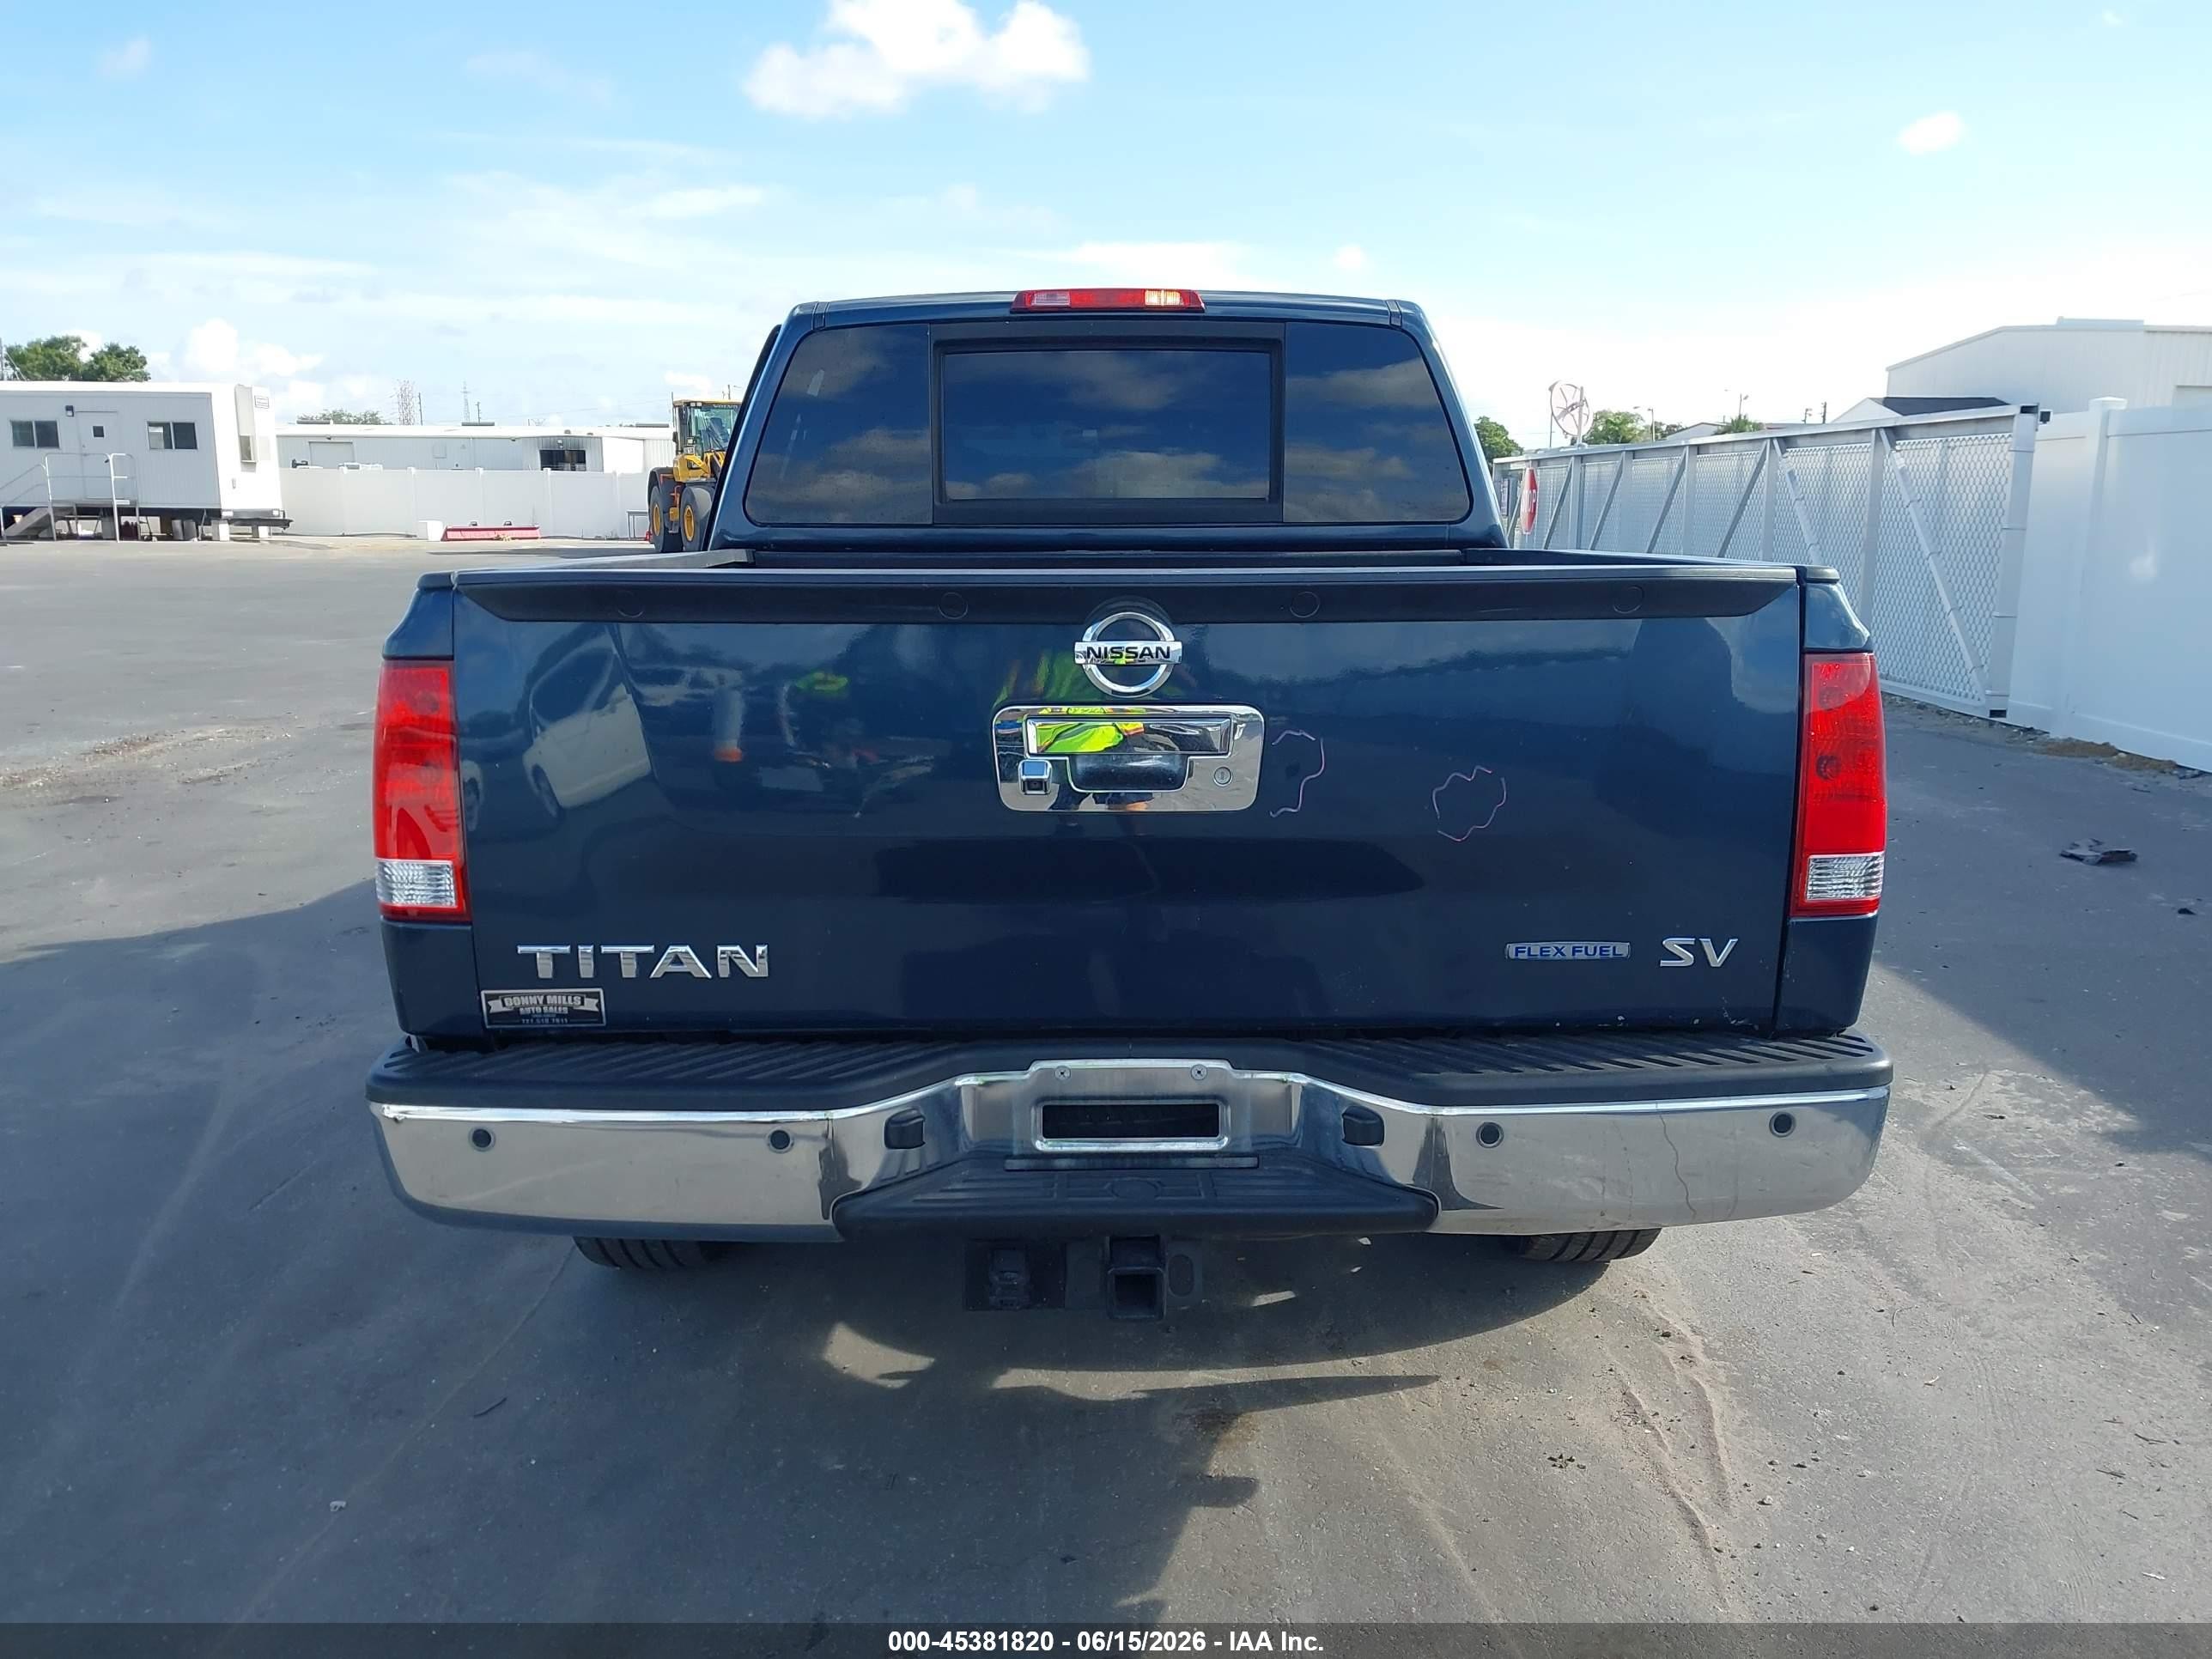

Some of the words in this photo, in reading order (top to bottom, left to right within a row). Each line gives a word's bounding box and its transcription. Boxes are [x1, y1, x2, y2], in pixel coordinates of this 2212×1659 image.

[1086, 646, 1170, 659] NISSAN
[1514, 945, 1567, 957] FLEX
[1571, 945, 1624, 957] FUEL
[1659, 937, 1739, 968] SV
[517, 944, 769, 979] TITAN
[546, 995, 581, 1006] MILLS
